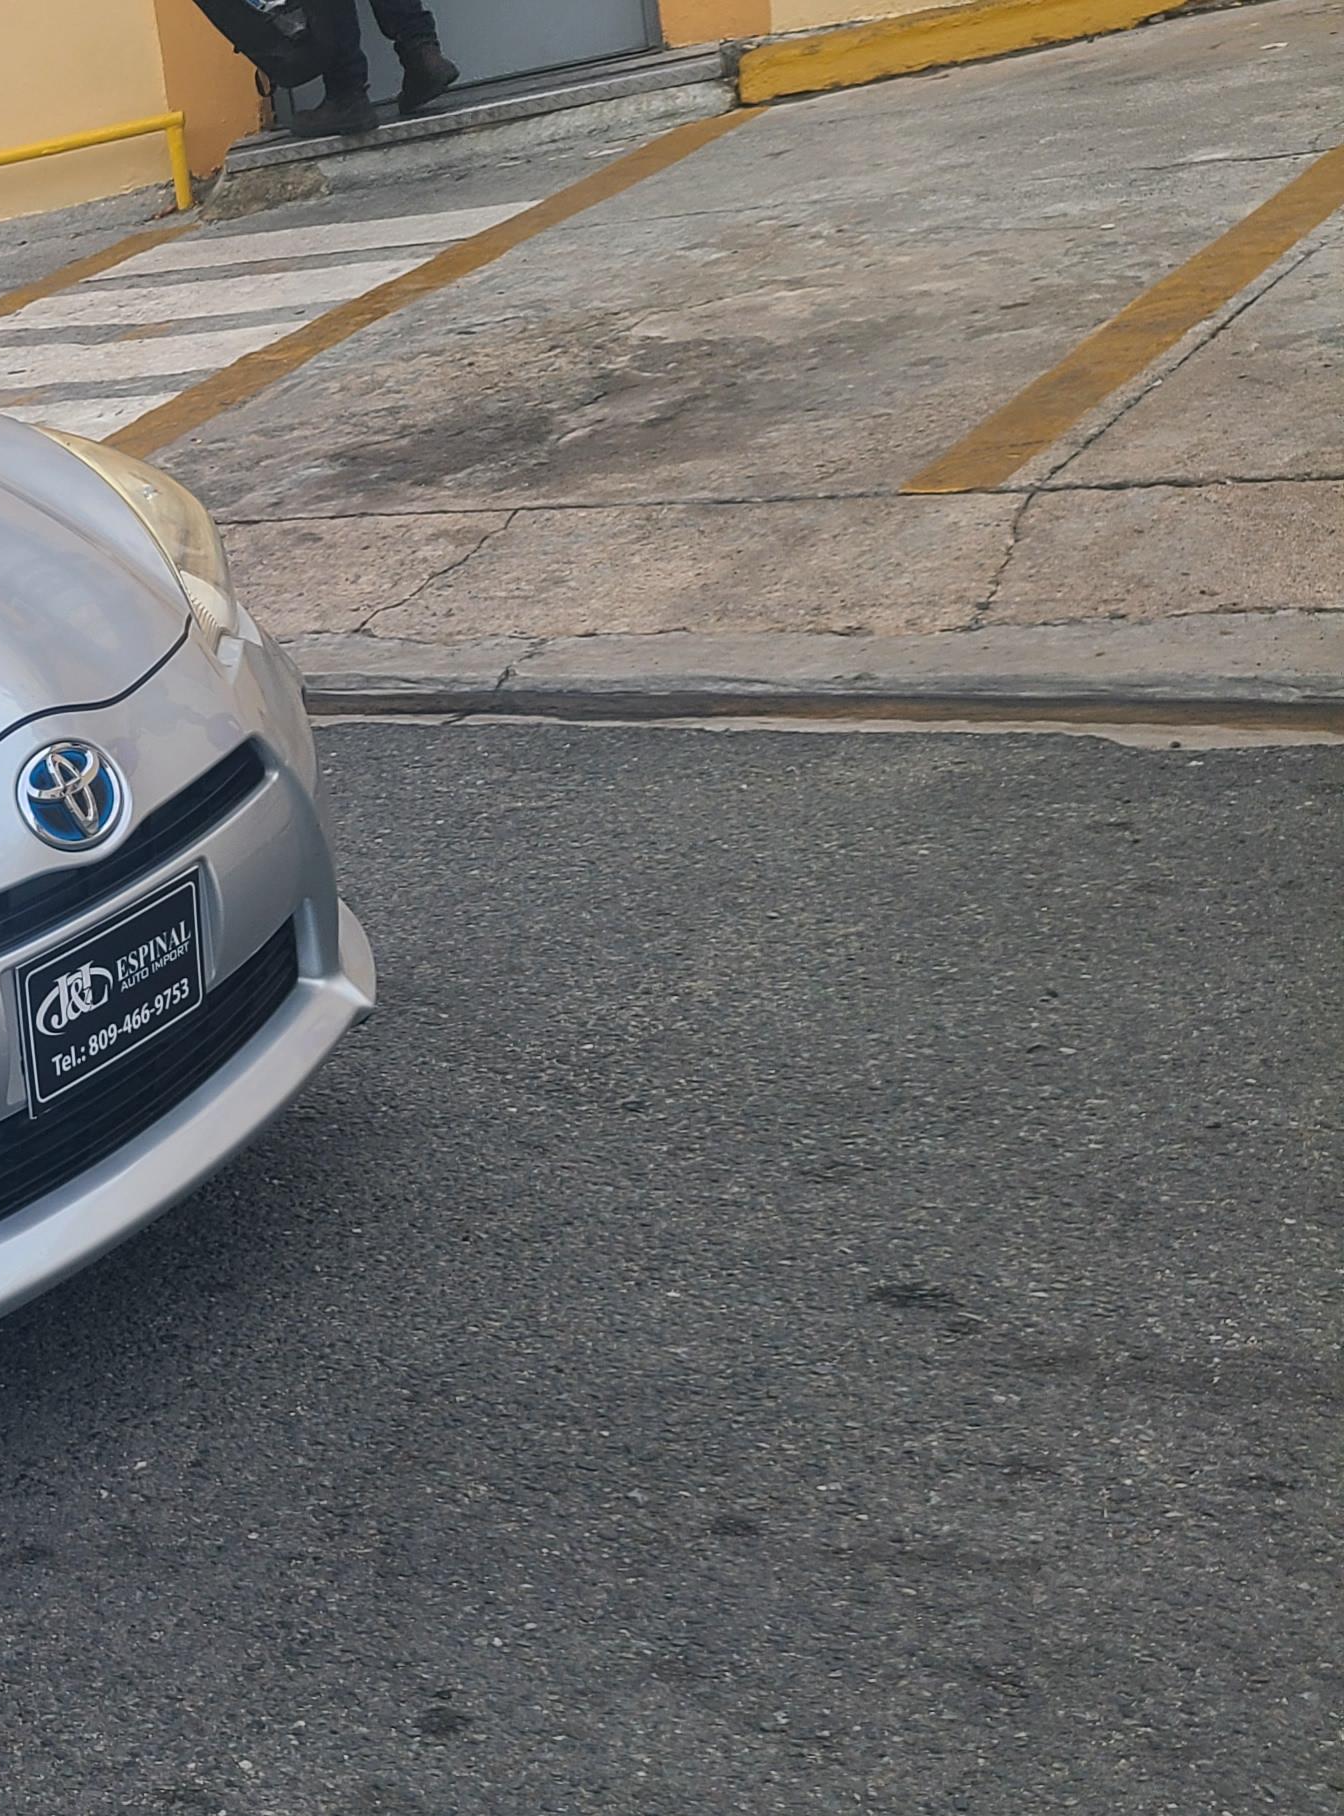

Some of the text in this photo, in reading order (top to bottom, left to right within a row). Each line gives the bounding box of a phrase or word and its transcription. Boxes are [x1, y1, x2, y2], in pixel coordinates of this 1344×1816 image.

[116, 920, 191, 982] ESPINAL
[120, 941, 190, 992] AUTO IMPORT
[51, 978, 190, 1076] Tel.: 809-466-9753
